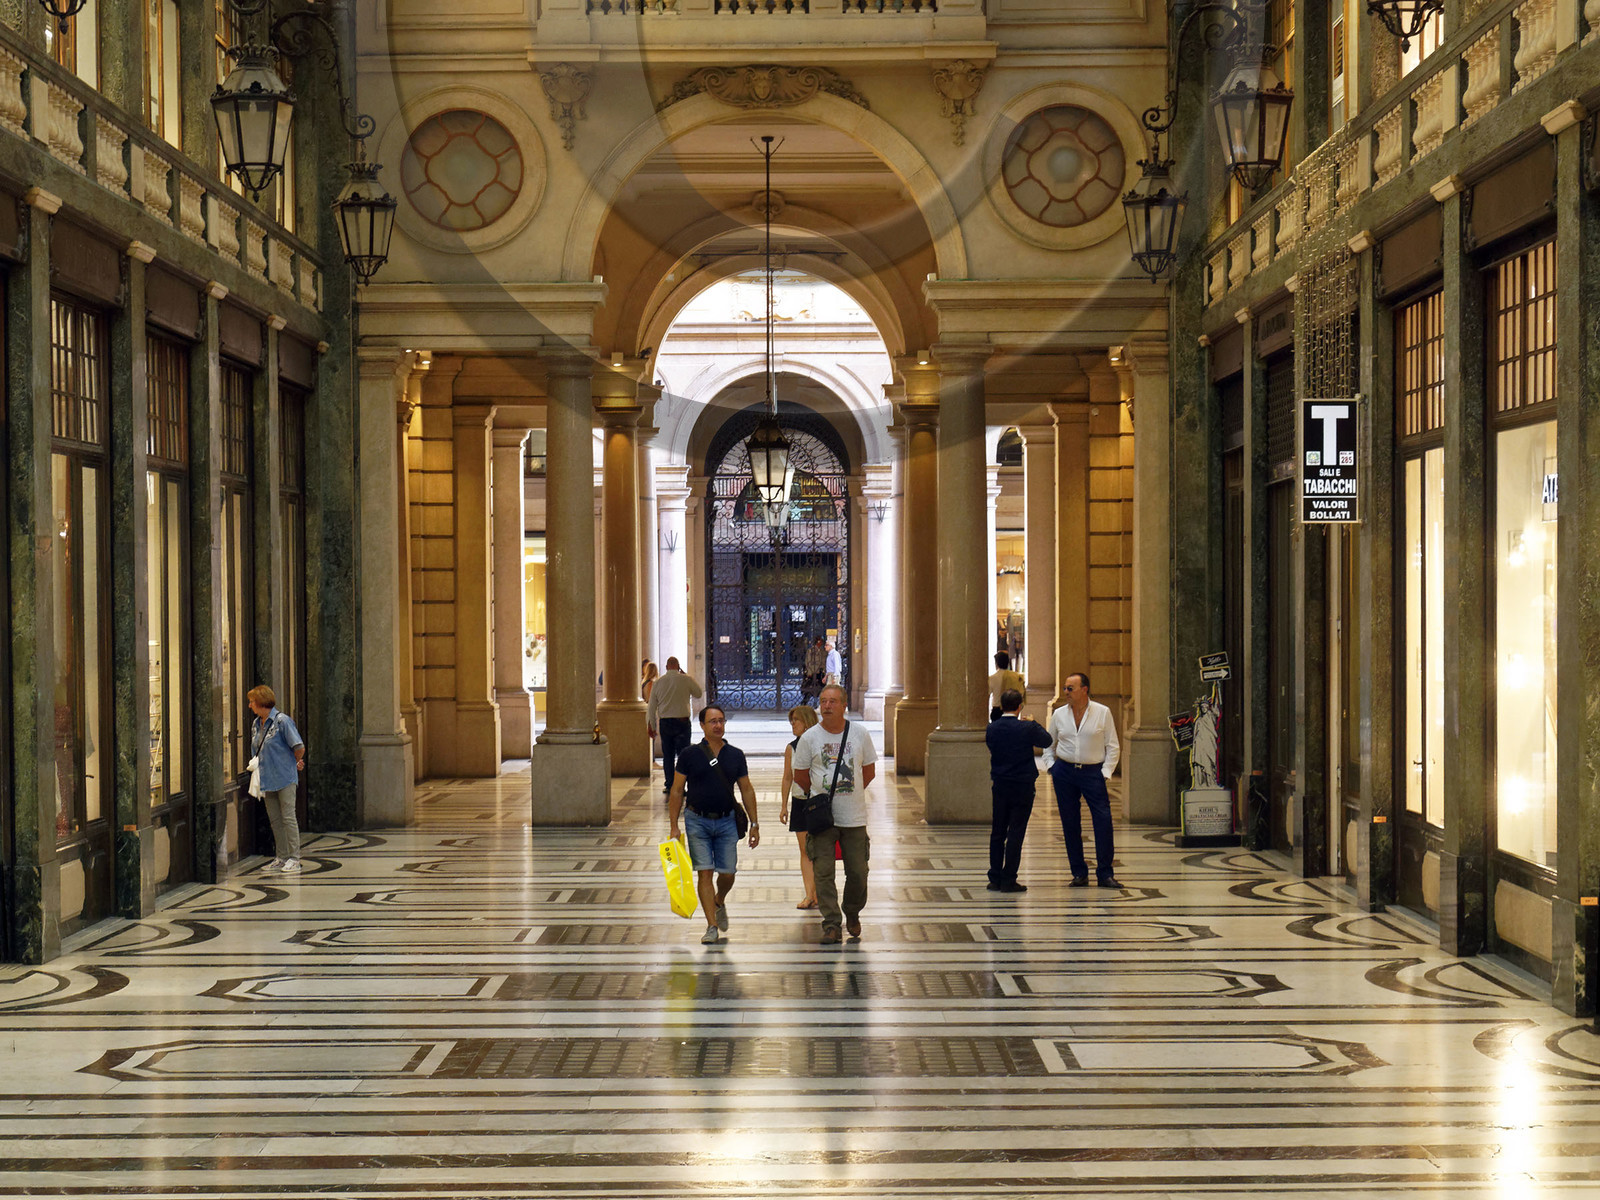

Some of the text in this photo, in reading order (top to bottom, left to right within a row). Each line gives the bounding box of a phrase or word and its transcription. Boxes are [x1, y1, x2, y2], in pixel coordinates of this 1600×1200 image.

[1311, 405, 1349, 465] T
[1319, 468, 1341, 477] SALI E
[1304, 479, 1356, 494] TABACCHI
[1312, 500, 1348, 509] VALORI
[1309, 511, 1350, 519] BOLLATI
